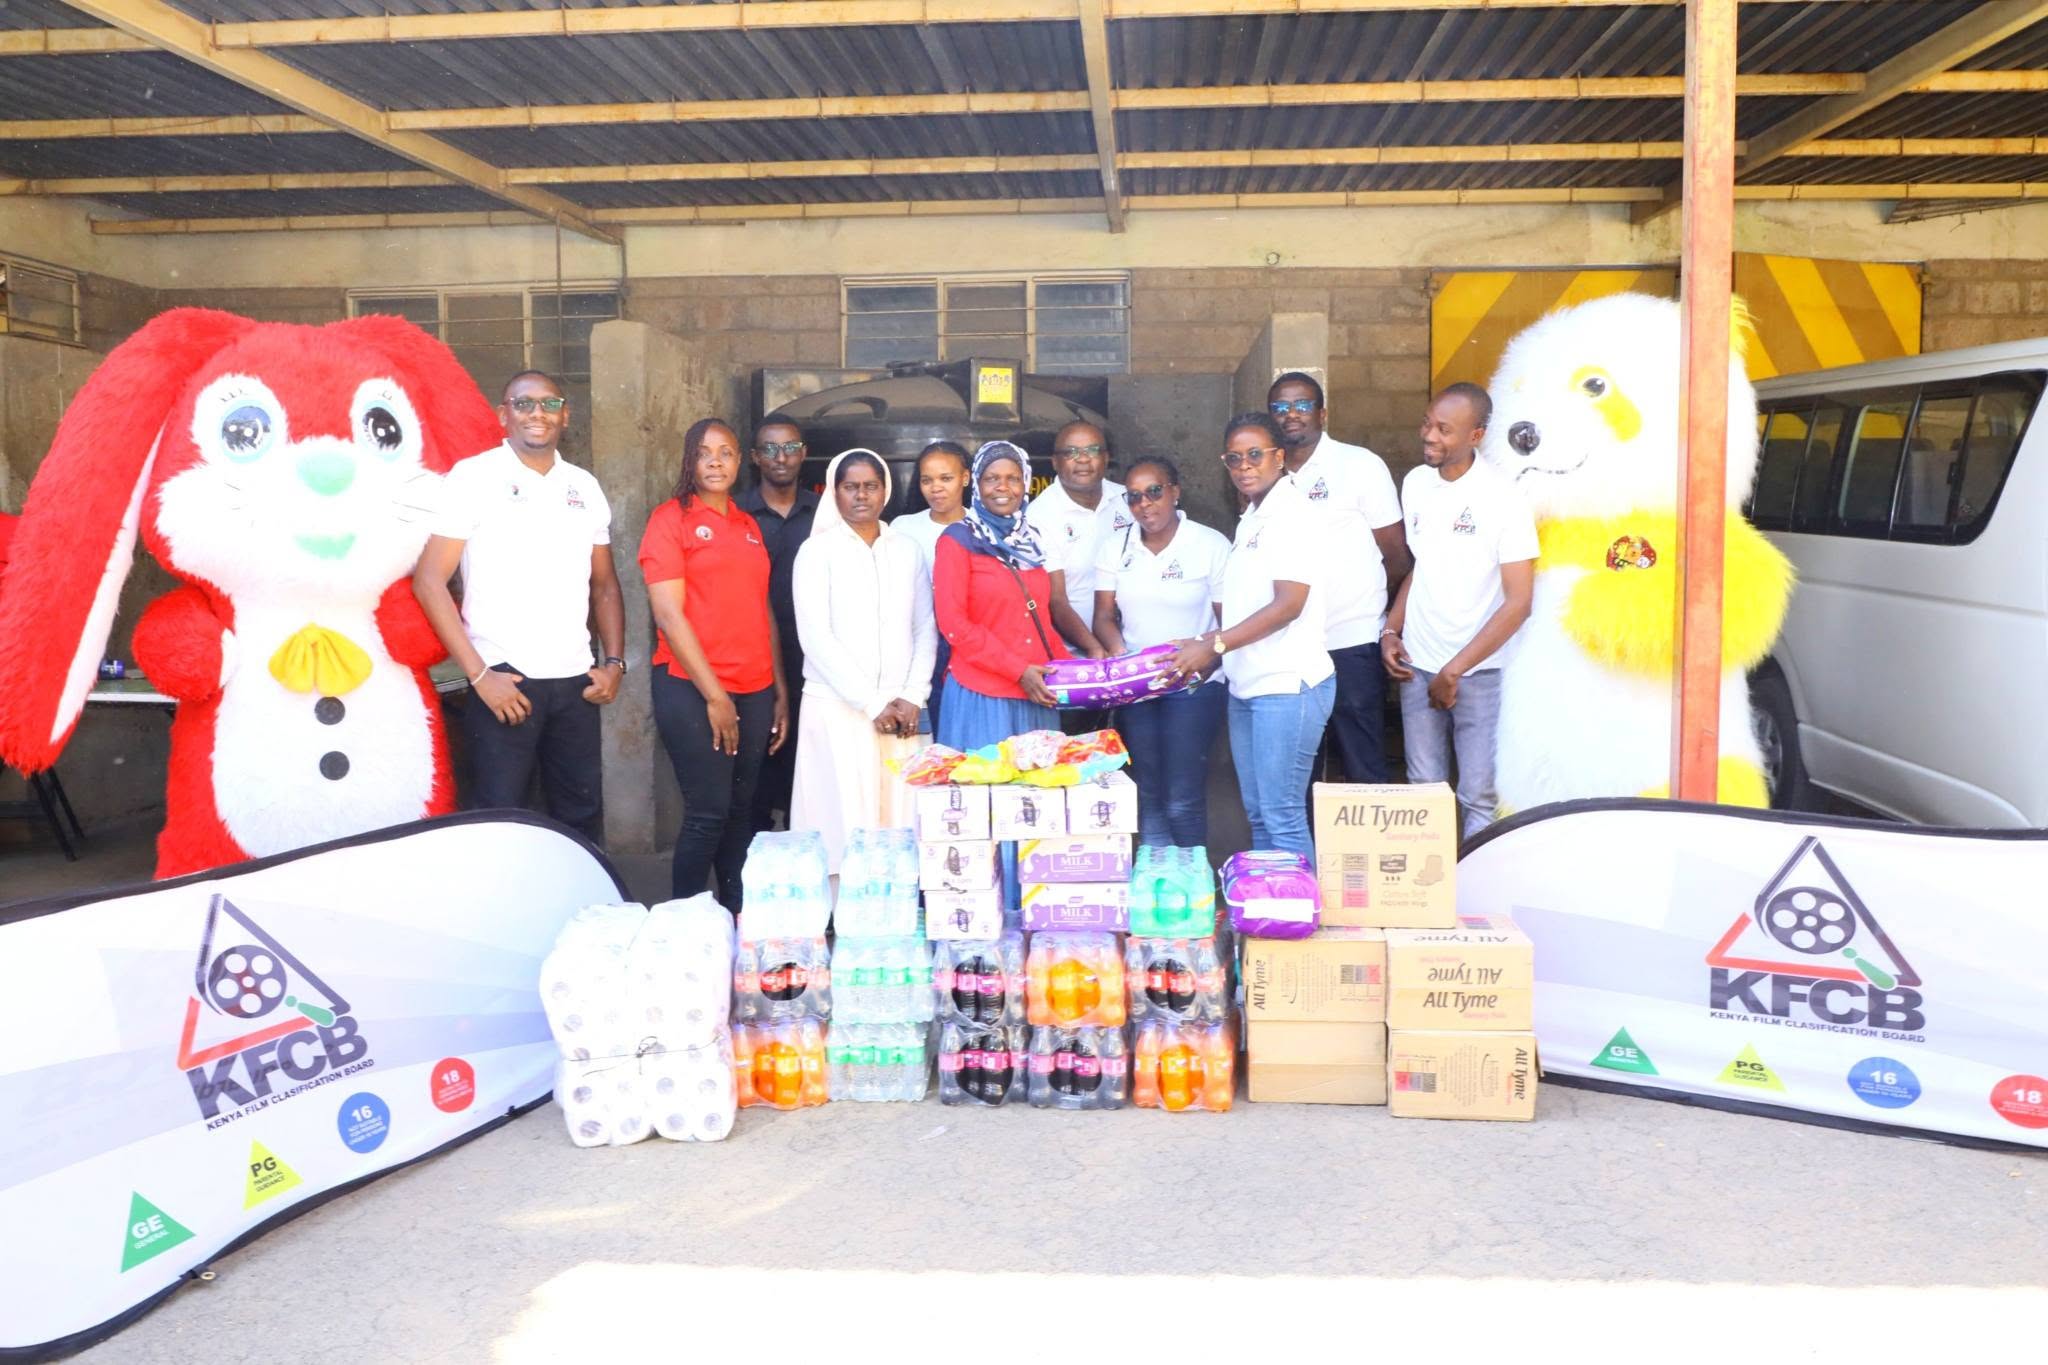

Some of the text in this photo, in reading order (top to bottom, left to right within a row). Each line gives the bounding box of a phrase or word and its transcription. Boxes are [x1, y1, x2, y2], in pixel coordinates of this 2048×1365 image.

[1333, 805, 1429, 832] All Tyme
[1061, 856, 1093, 865] MILK
[1061, 908, 1093, 917] MILK
[1253, 959, 1269, 1010] All Tyme
[1427, 962, 1503, 985] All Tyme
[1422, 991, 1499, 1013] All Tyme
[1710, 967, 1926, 1032] KFCB
[1709, 1011, 1926, 1043] KENYA FILM CLASIFICATION BOARD
[1609, 1046, 1639, 1059] GE
[187, 1016, 368, 1120] KFCB
[441, 1069, 461, 1085] 18
[1511, 1047, 1528, 1100] All Tyme
[1735, 1060, 1765, 1072] PG
[1869, 1070, 1898, 1085] 16
[206, 1058, 376, 1132] KENYA FILM CLASIFICATION BOARD
[2012, 1088, 2043, 1105] 18
[351, 1105, 373, 1122] 16
[251, 1156, 278, 1177] PG
[131, 1213, 166, 1239] GE
